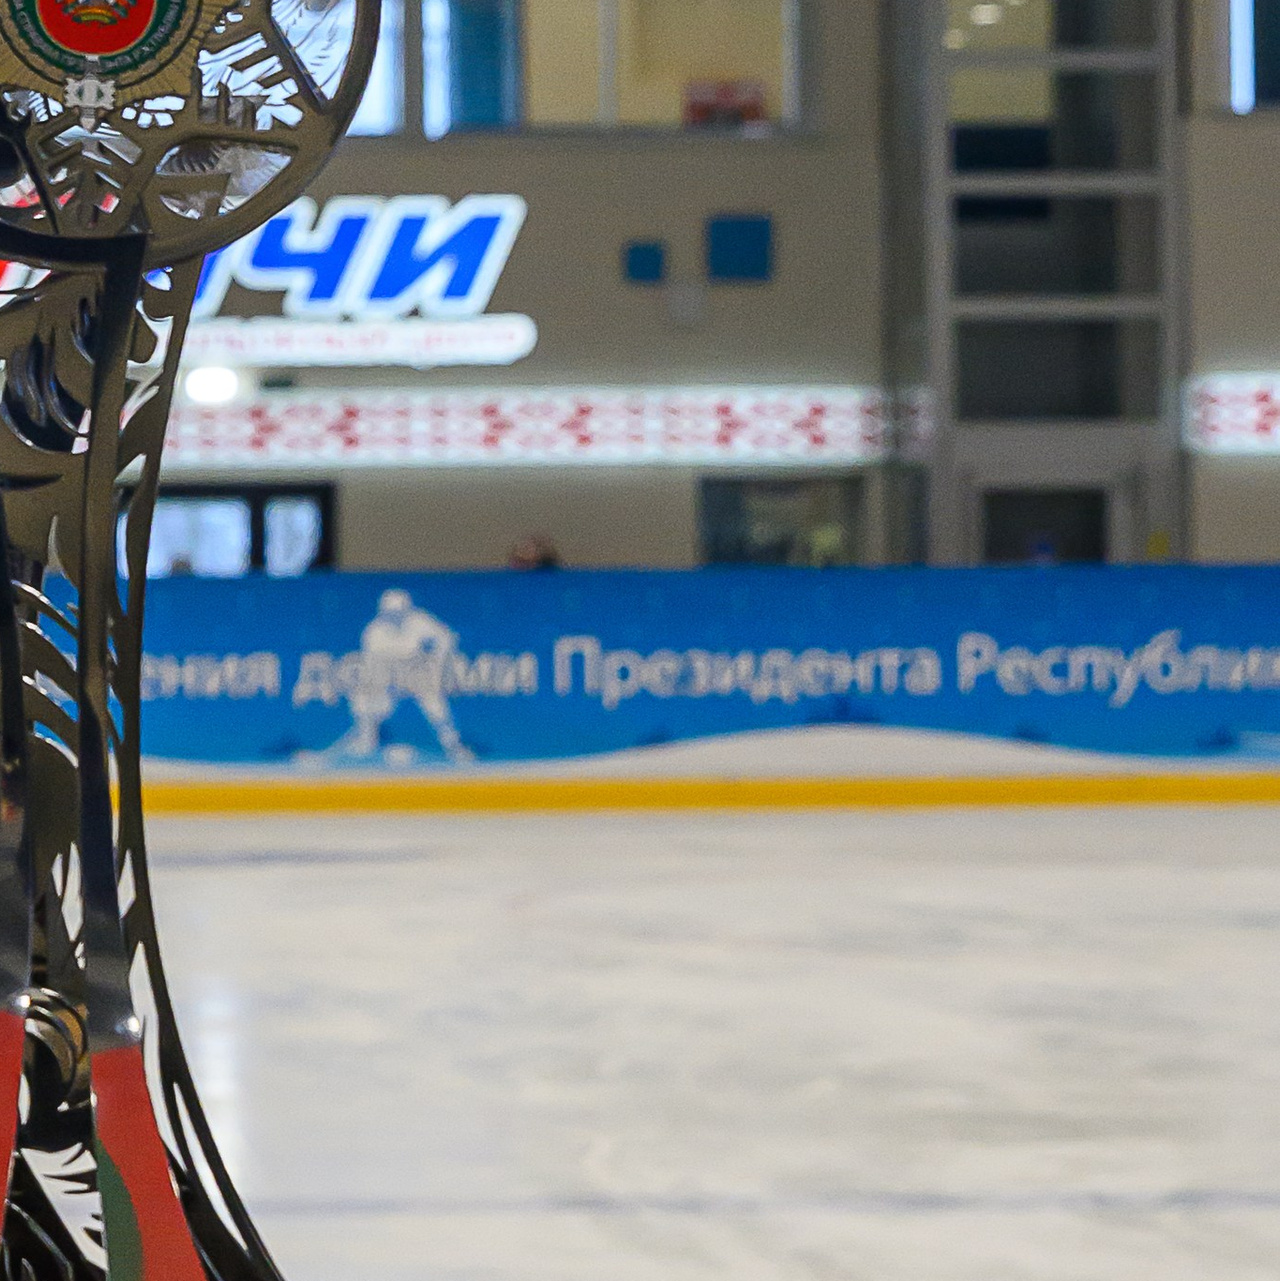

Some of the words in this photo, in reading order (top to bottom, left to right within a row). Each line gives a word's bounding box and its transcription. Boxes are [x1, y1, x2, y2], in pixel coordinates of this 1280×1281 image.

[292, 651, 538, 709] деми
[553, 634, 942, 711] Президента
[957, 627, 1280, 709] Республи
